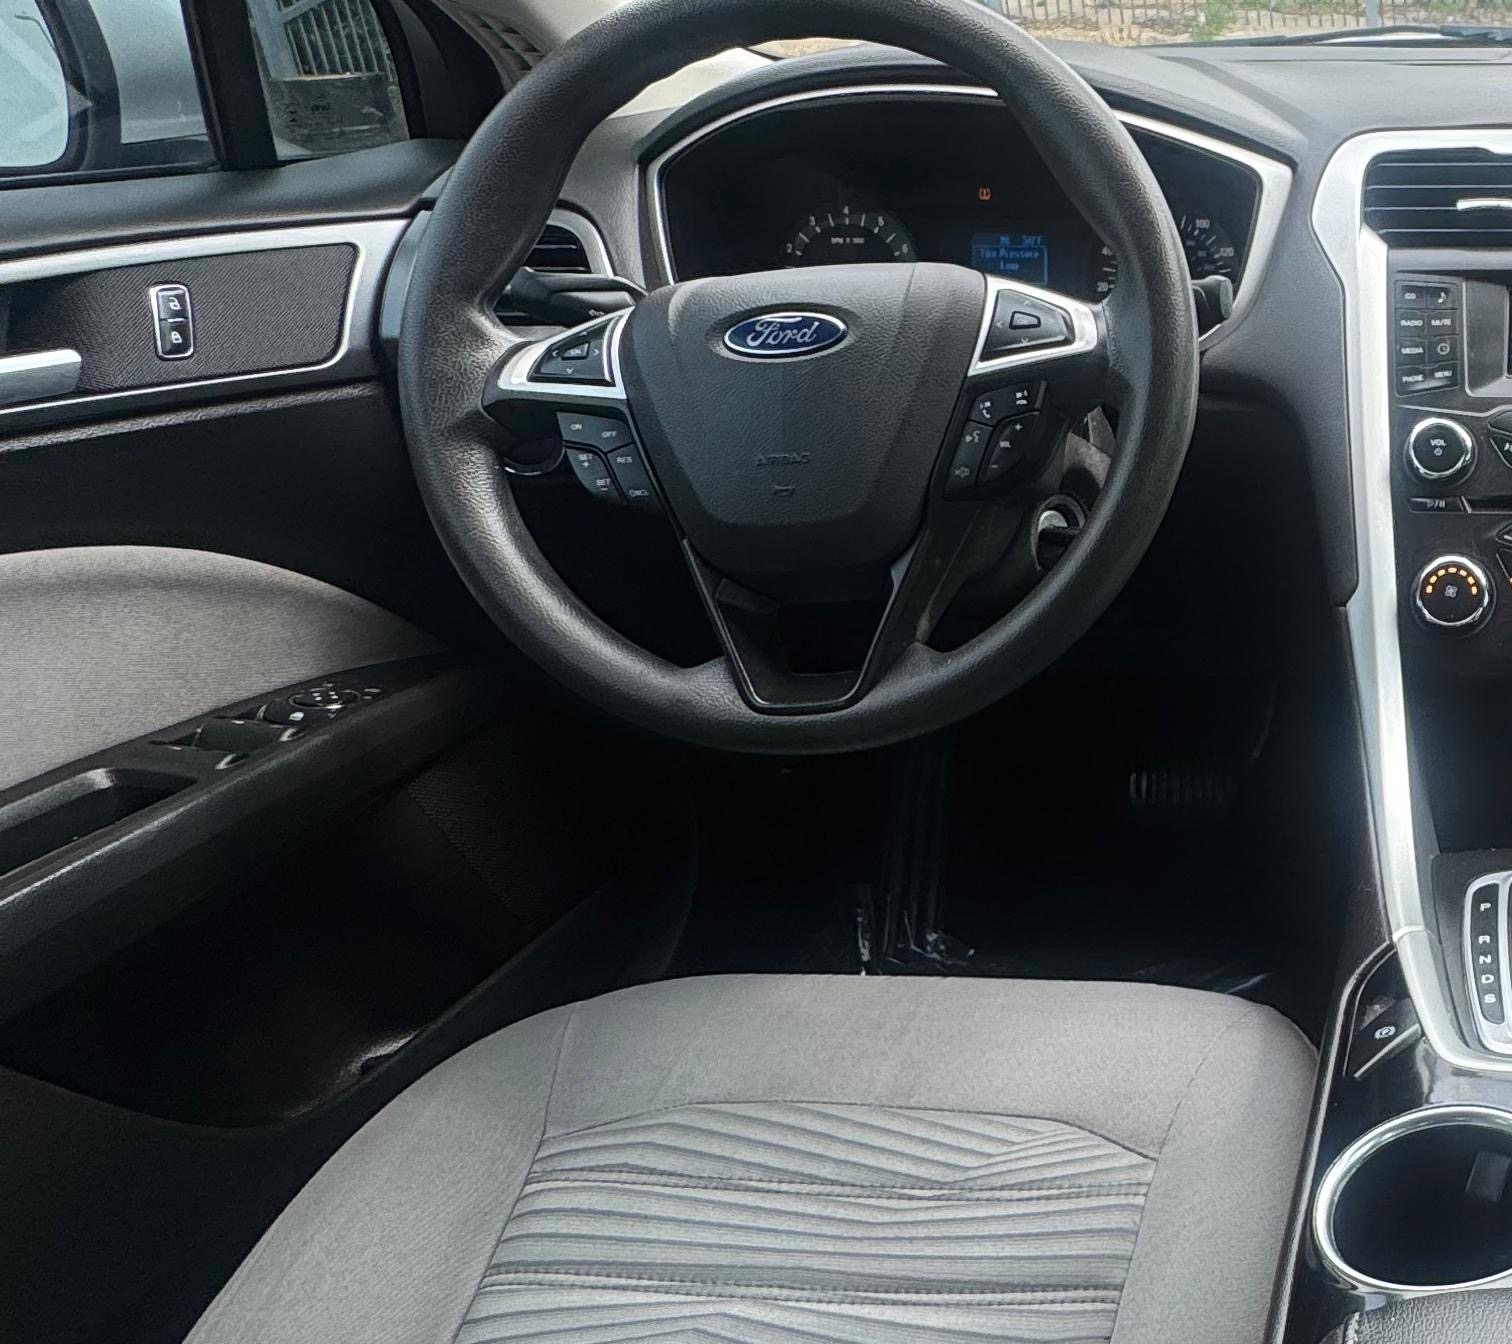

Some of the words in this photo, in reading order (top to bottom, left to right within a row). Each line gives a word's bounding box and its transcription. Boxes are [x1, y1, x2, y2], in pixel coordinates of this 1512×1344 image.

[843, 205, 849, 215] 4
[809, 216, 816, 226] 3
[878, 216, 885, 226] 5
[786, 243, 793, 253] 2
[902, 244, 909, 254] 6
[746, 316, 820, 347] Ford
[570, 423, 583, 431] ON
[601, 430, 618, 439] OFF
[1430, 439, 1446, 447] VOL
[1480, 902, 1492, 912] P
[1479, 935, 1491, 944] R
[1479, 955, 1492, 964] N
[1481, 974, 1495, 984] D
[1484, 994, 1496, 1004] S
